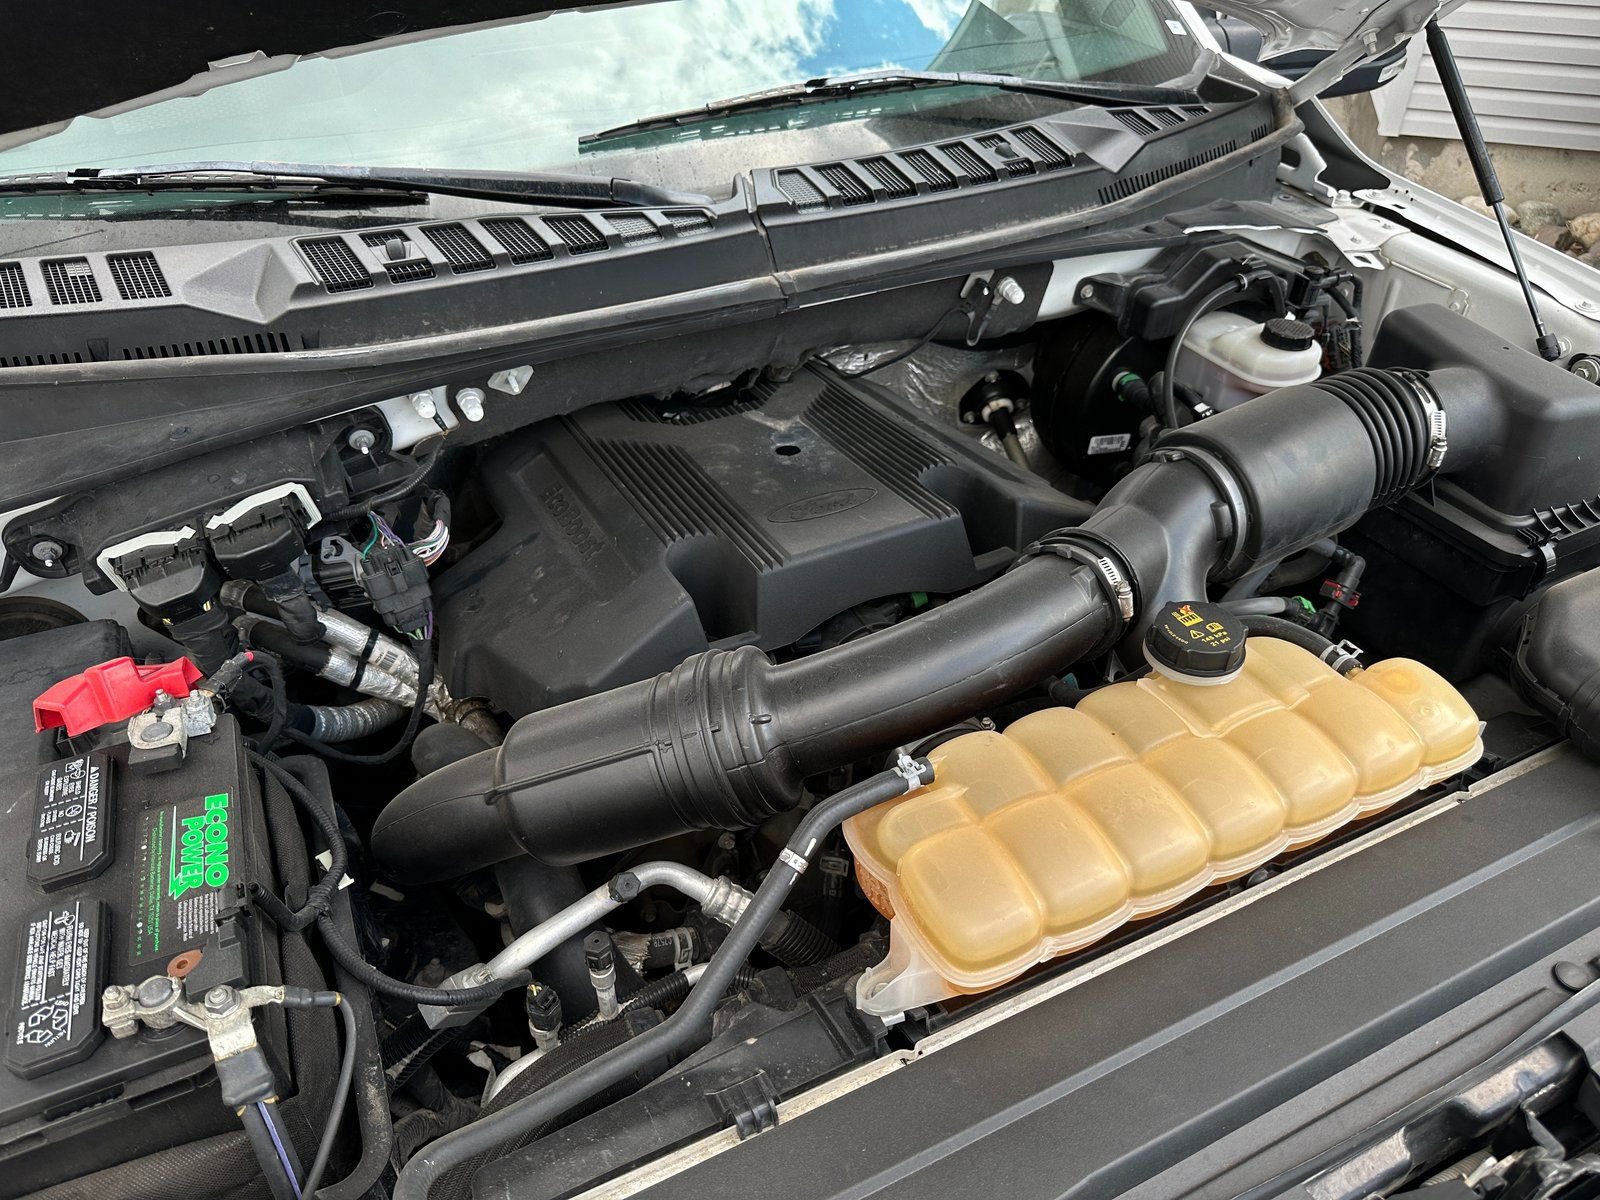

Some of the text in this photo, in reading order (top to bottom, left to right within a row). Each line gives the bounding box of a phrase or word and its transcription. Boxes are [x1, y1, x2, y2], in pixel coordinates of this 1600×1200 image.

[785, 490, 863, 521] Ford
[1201, 635, 1215, 643] 145
[1219, 636, 1232, 644] psi
[88, 773, 99, 805] DANGER
[85, 812, 97, 843] POISON
[204, 793, 229, 888] ECONO
[180, 816, 205, 889] POWER
